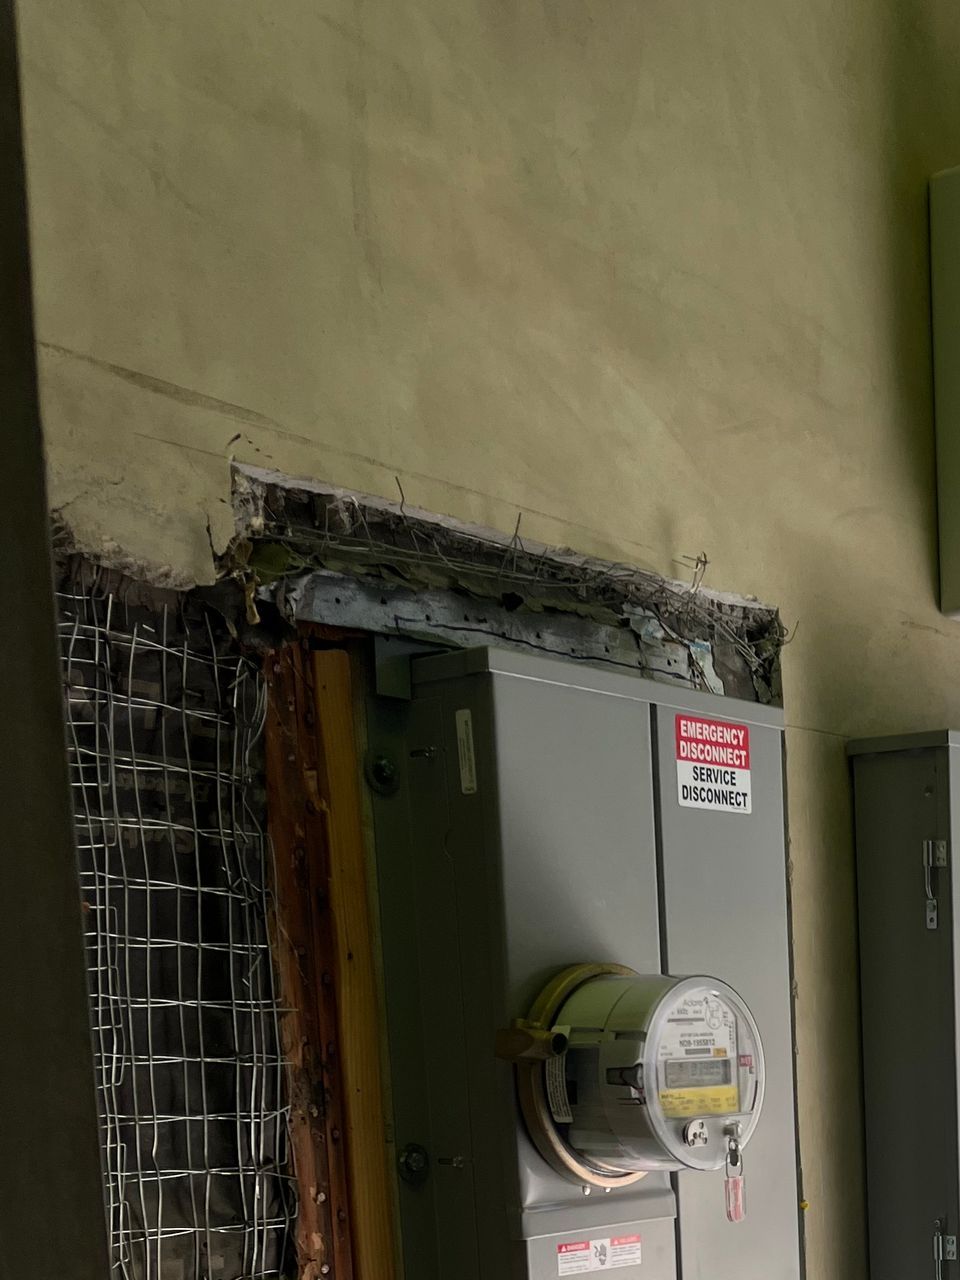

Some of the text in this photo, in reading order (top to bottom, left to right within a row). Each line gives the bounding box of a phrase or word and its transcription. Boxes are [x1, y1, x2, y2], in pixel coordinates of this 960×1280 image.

[680, 719, 745, 747] EMERGENCY
[680, 740, 747, 767] DISCONNECT
[692, 765, 737, 787] SERVICE
[682, 784, 748, 808] DISCONNECT
